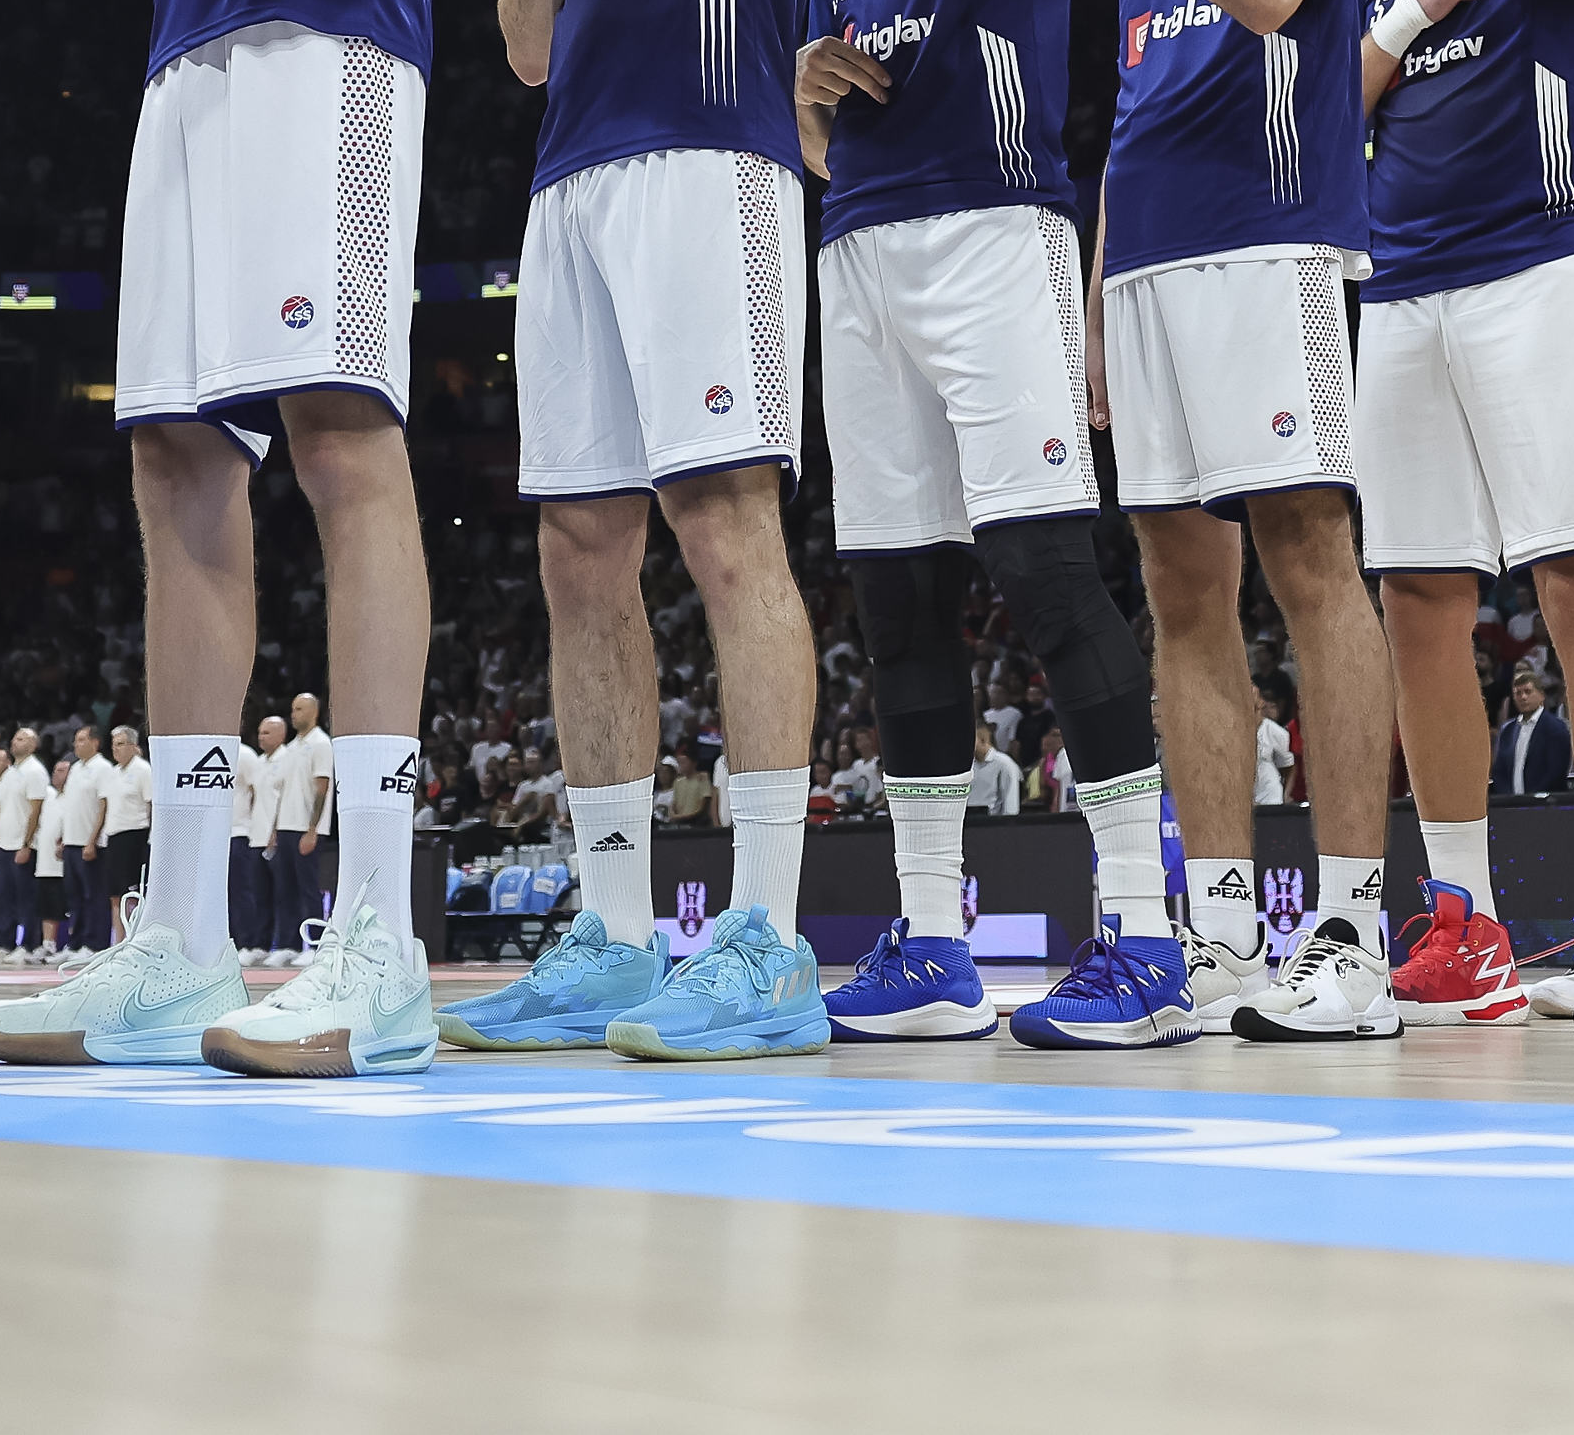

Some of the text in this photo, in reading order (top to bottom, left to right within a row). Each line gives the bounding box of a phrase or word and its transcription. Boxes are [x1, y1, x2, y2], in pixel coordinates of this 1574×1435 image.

[285, 311, 311, 321] KSS
[709, 398, 732, 408] KSS
[1276, 422, 1295, 432] KSS
[1047, 450, 1065, 459] KSS
[176, 775, 236, 791] PEAK
[589, 842, 635, 854] adidas
[1207, 886, 1254, 902] PEAK
